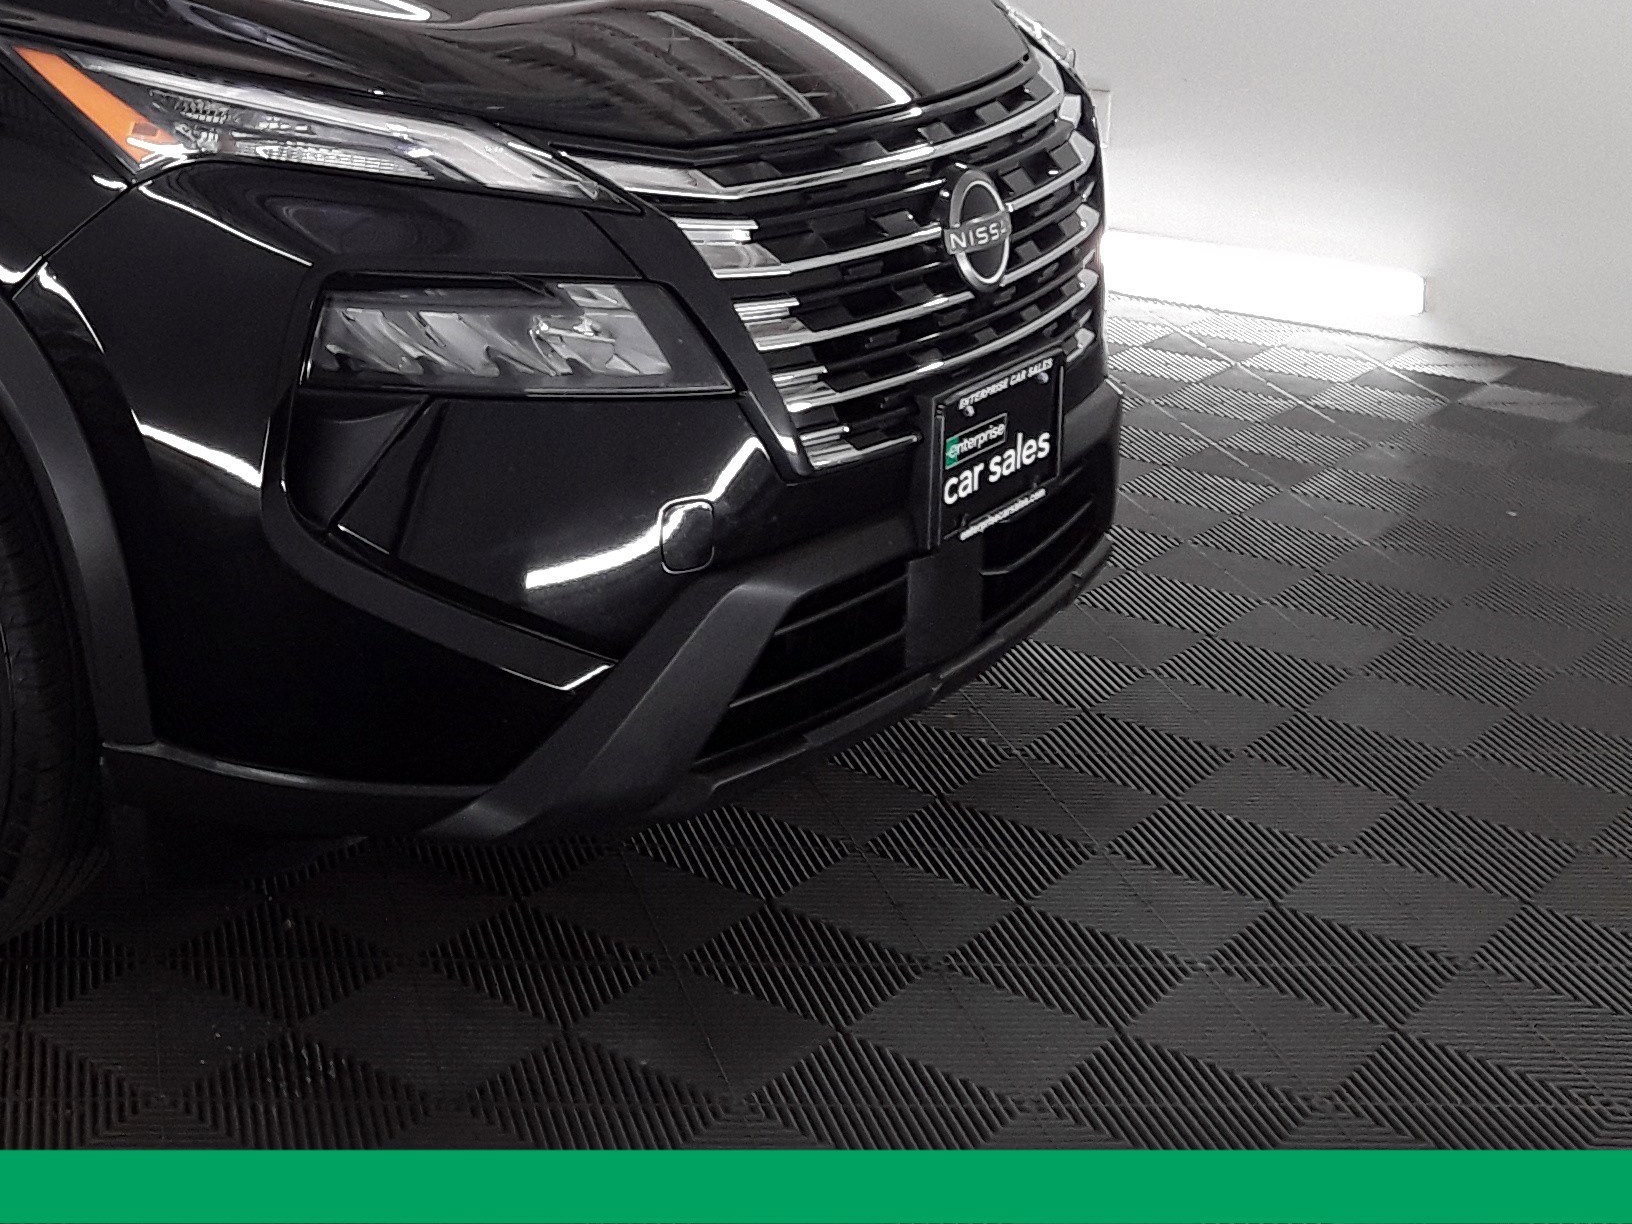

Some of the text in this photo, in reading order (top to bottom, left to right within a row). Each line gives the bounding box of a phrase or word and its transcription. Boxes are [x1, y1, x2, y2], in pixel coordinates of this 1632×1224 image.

[950, 220, 1007, 250] NISS
[947, 423, 1006, 459] enterprise
[944, 431, 1051, 505] car sales
